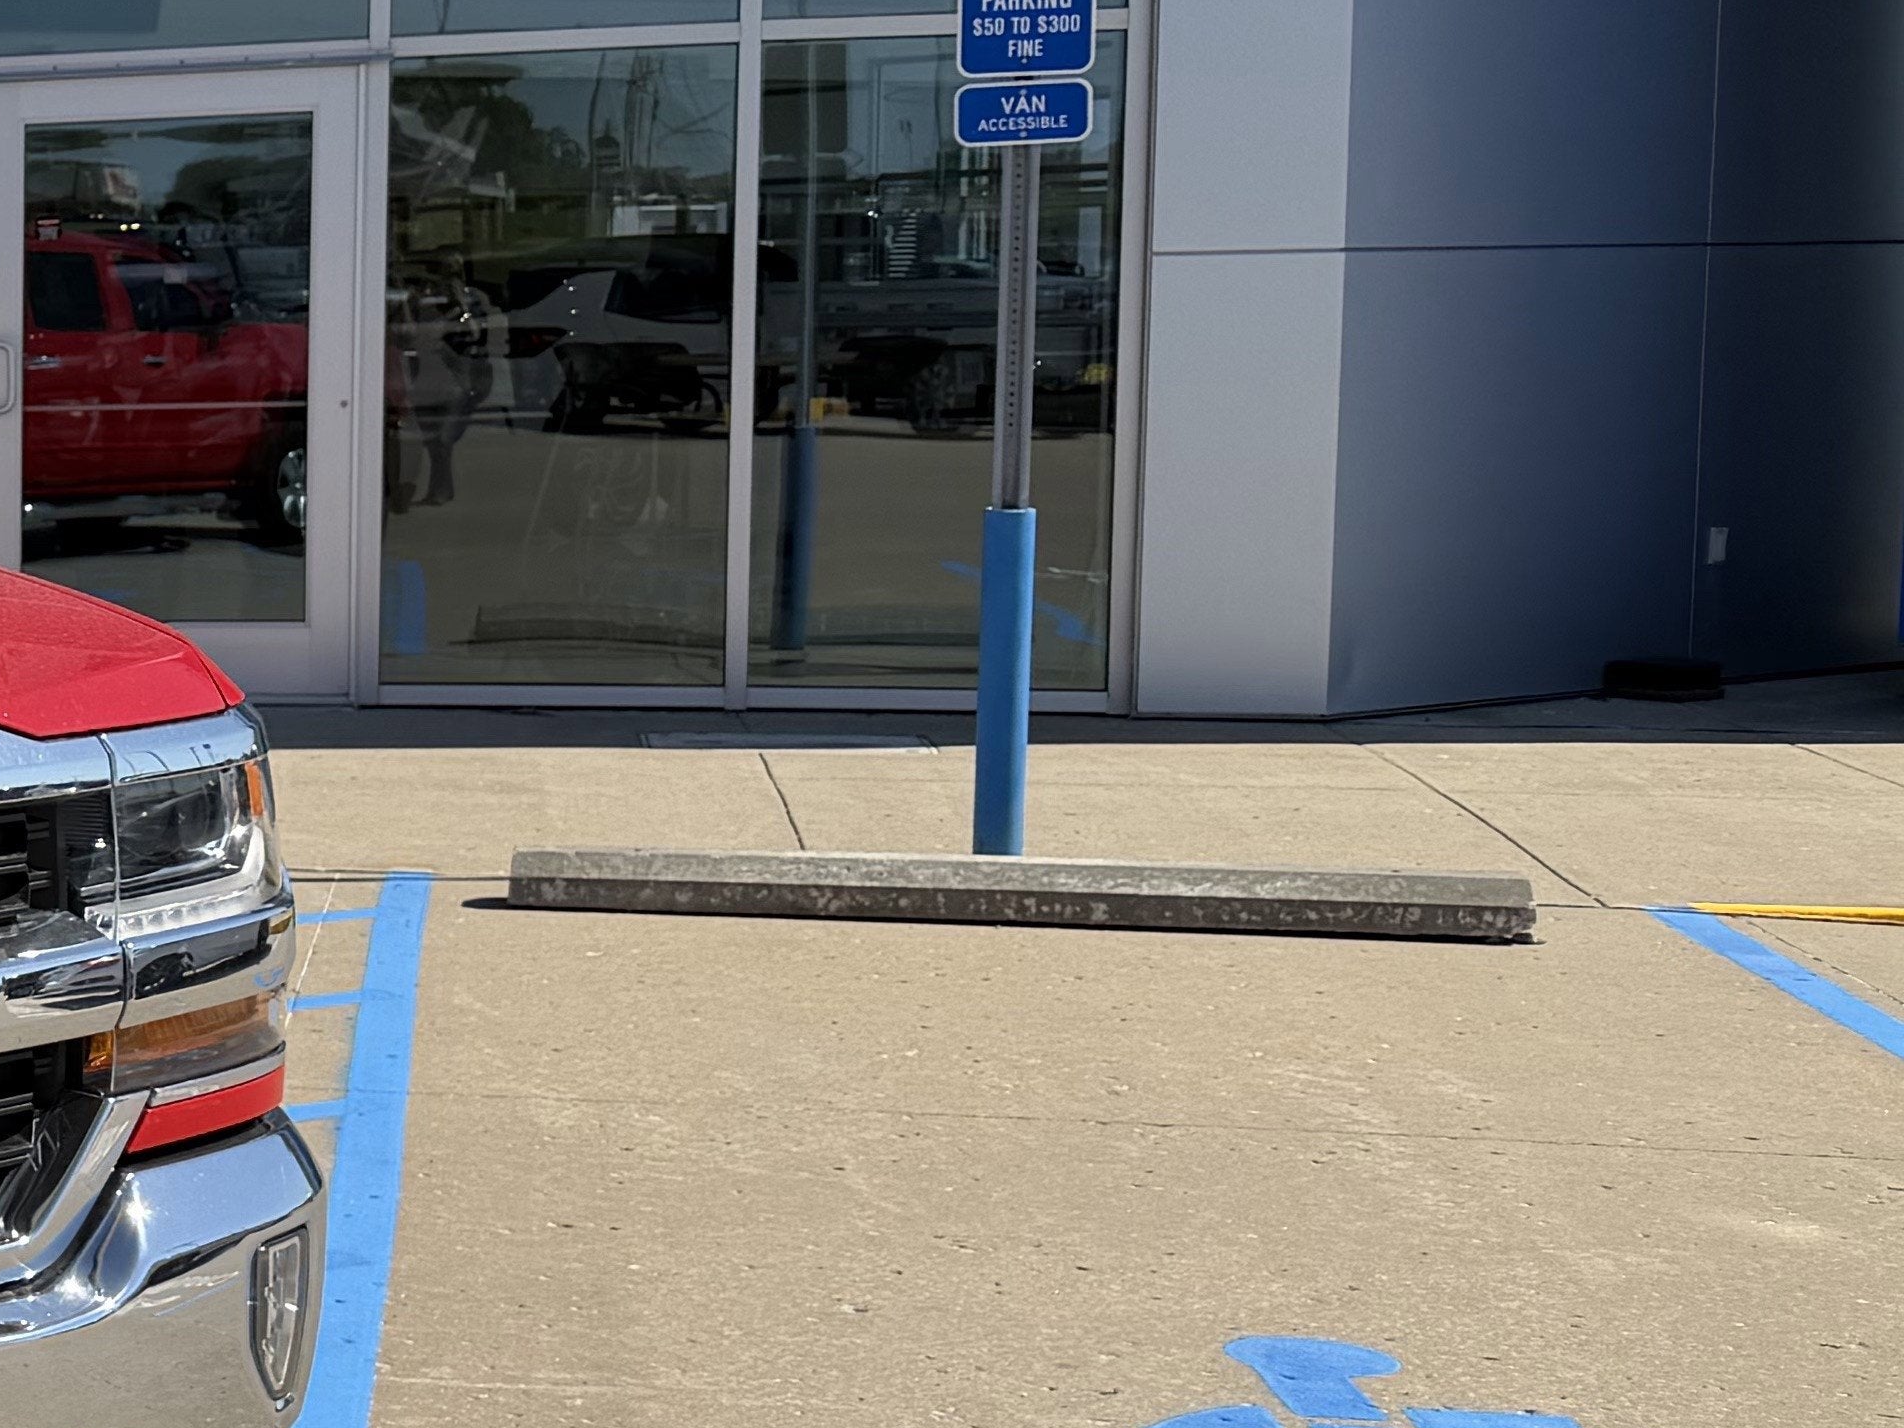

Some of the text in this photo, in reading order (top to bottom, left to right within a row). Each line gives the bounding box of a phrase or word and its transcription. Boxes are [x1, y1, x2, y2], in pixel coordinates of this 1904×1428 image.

[973, 14, 1081, 36] $50 TO $300
[1008, 39, 1043, 57] FINE
[1001, 94, 1046, 114] VAN
[978, 115, 1068, 132] ACCESSIBLE
